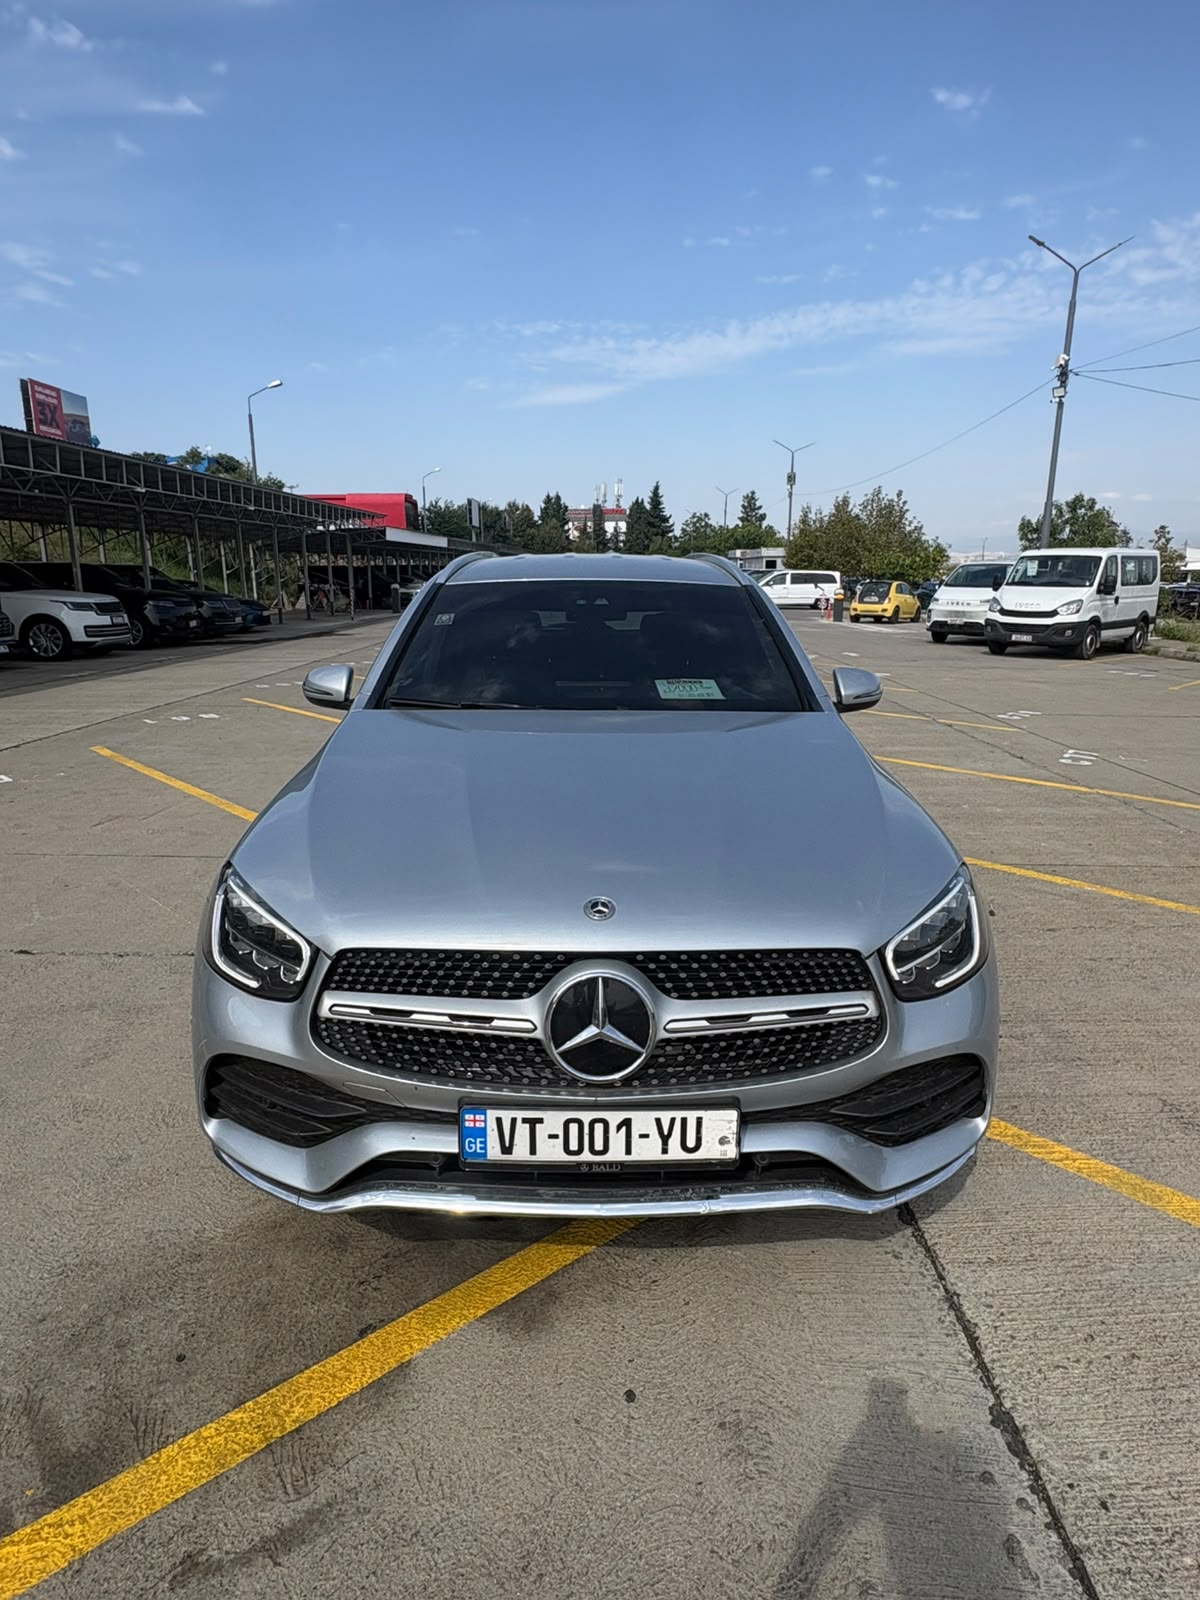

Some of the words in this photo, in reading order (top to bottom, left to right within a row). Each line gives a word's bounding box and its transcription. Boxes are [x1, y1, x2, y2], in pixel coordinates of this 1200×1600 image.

[37, 401, 60, 429] 3X
[465, 1138, 485, 1153] GE
[495, 1116, 703, 1156] VT-001-YU
